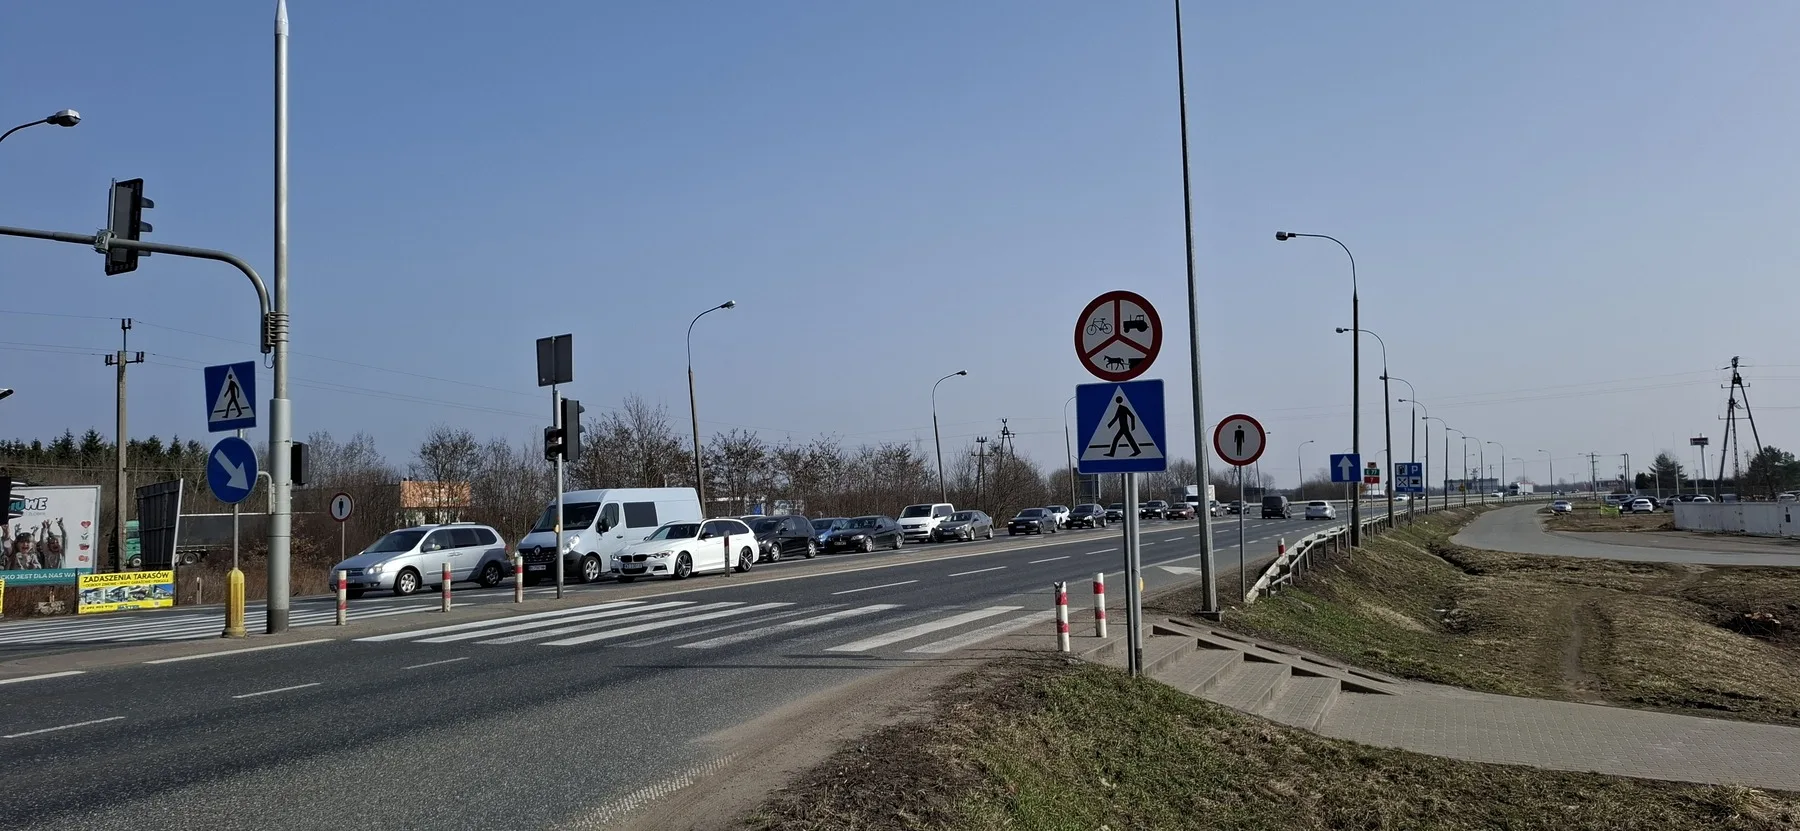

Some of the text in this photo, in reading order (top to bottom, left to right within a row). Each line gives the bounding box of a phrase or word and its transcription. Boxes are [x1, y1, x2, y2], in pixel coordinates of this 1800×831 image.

[1412, 466, 1418, 474] P
[84, 572, 169, 582] ZADASZENIA TARASÓW
